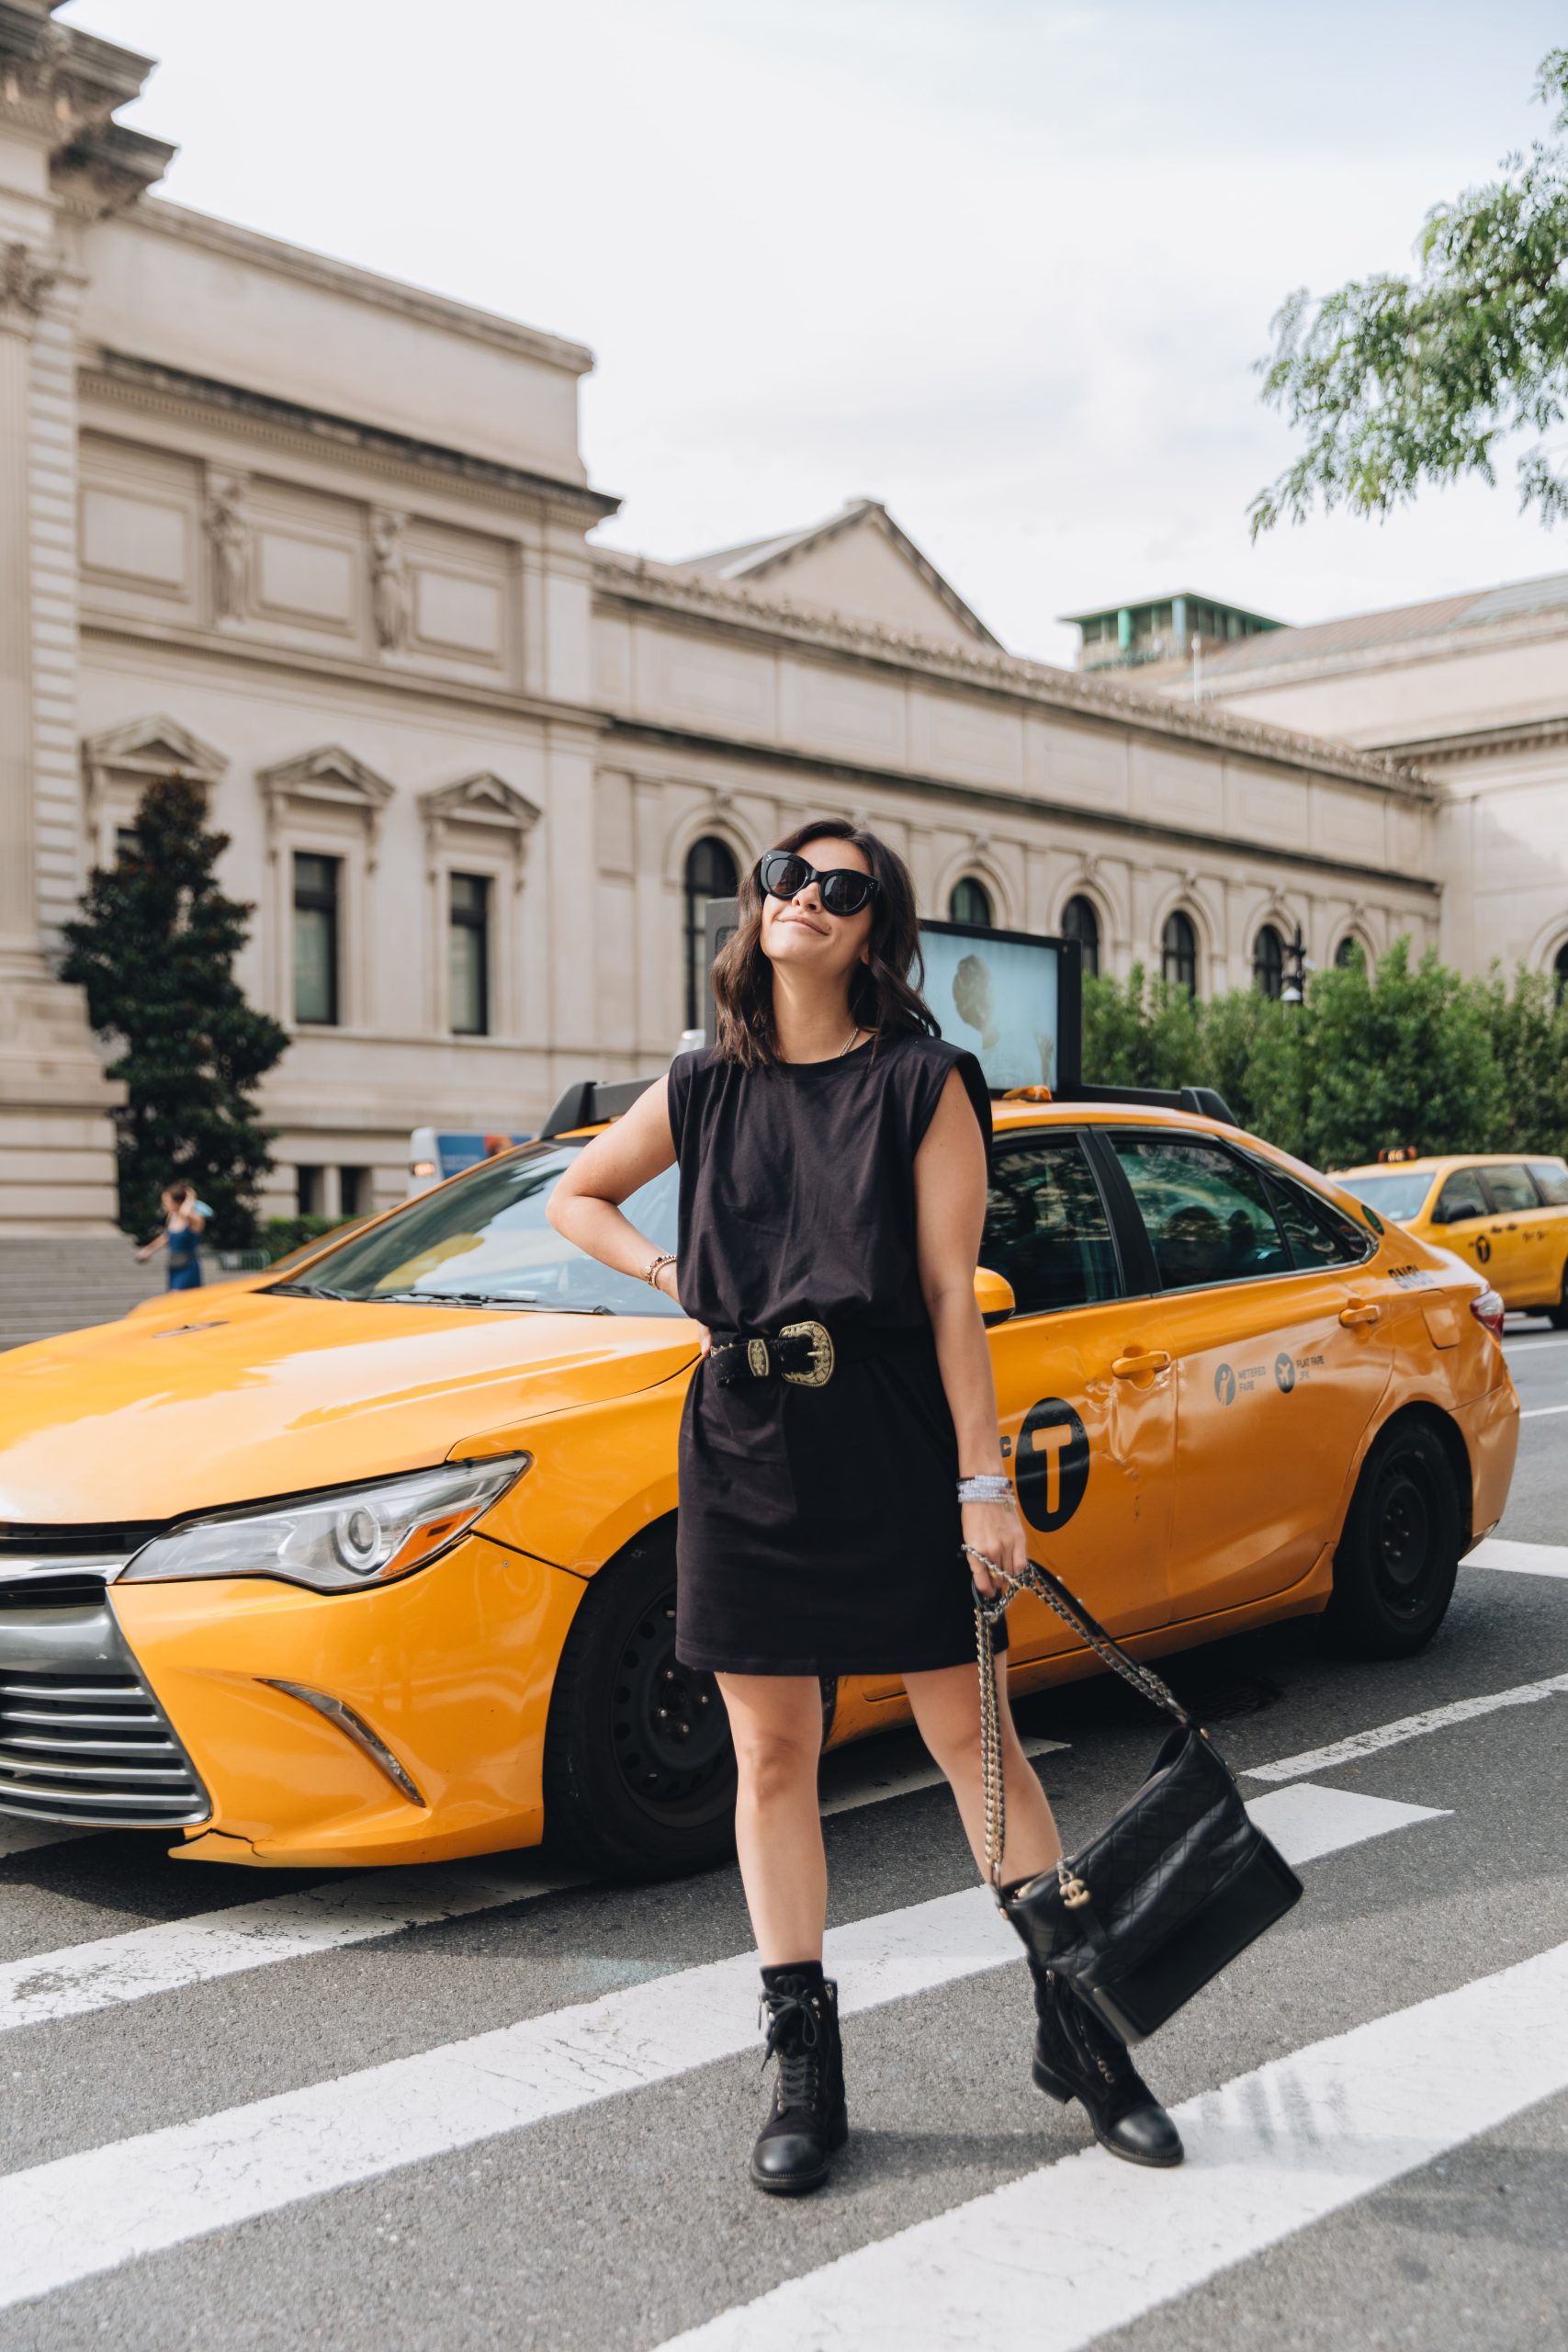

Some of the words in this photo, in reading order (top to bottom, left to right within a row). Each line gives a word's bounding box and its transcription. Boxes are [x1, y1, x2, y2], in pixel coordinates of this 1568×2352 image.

[1311, 1355, 1325, 1366] FARE
[1237, 1365, 1266, 1379] METERED
[1238, 1381, 1255, 1392] FARE
[1032, 1424, 1072, 1514] T
